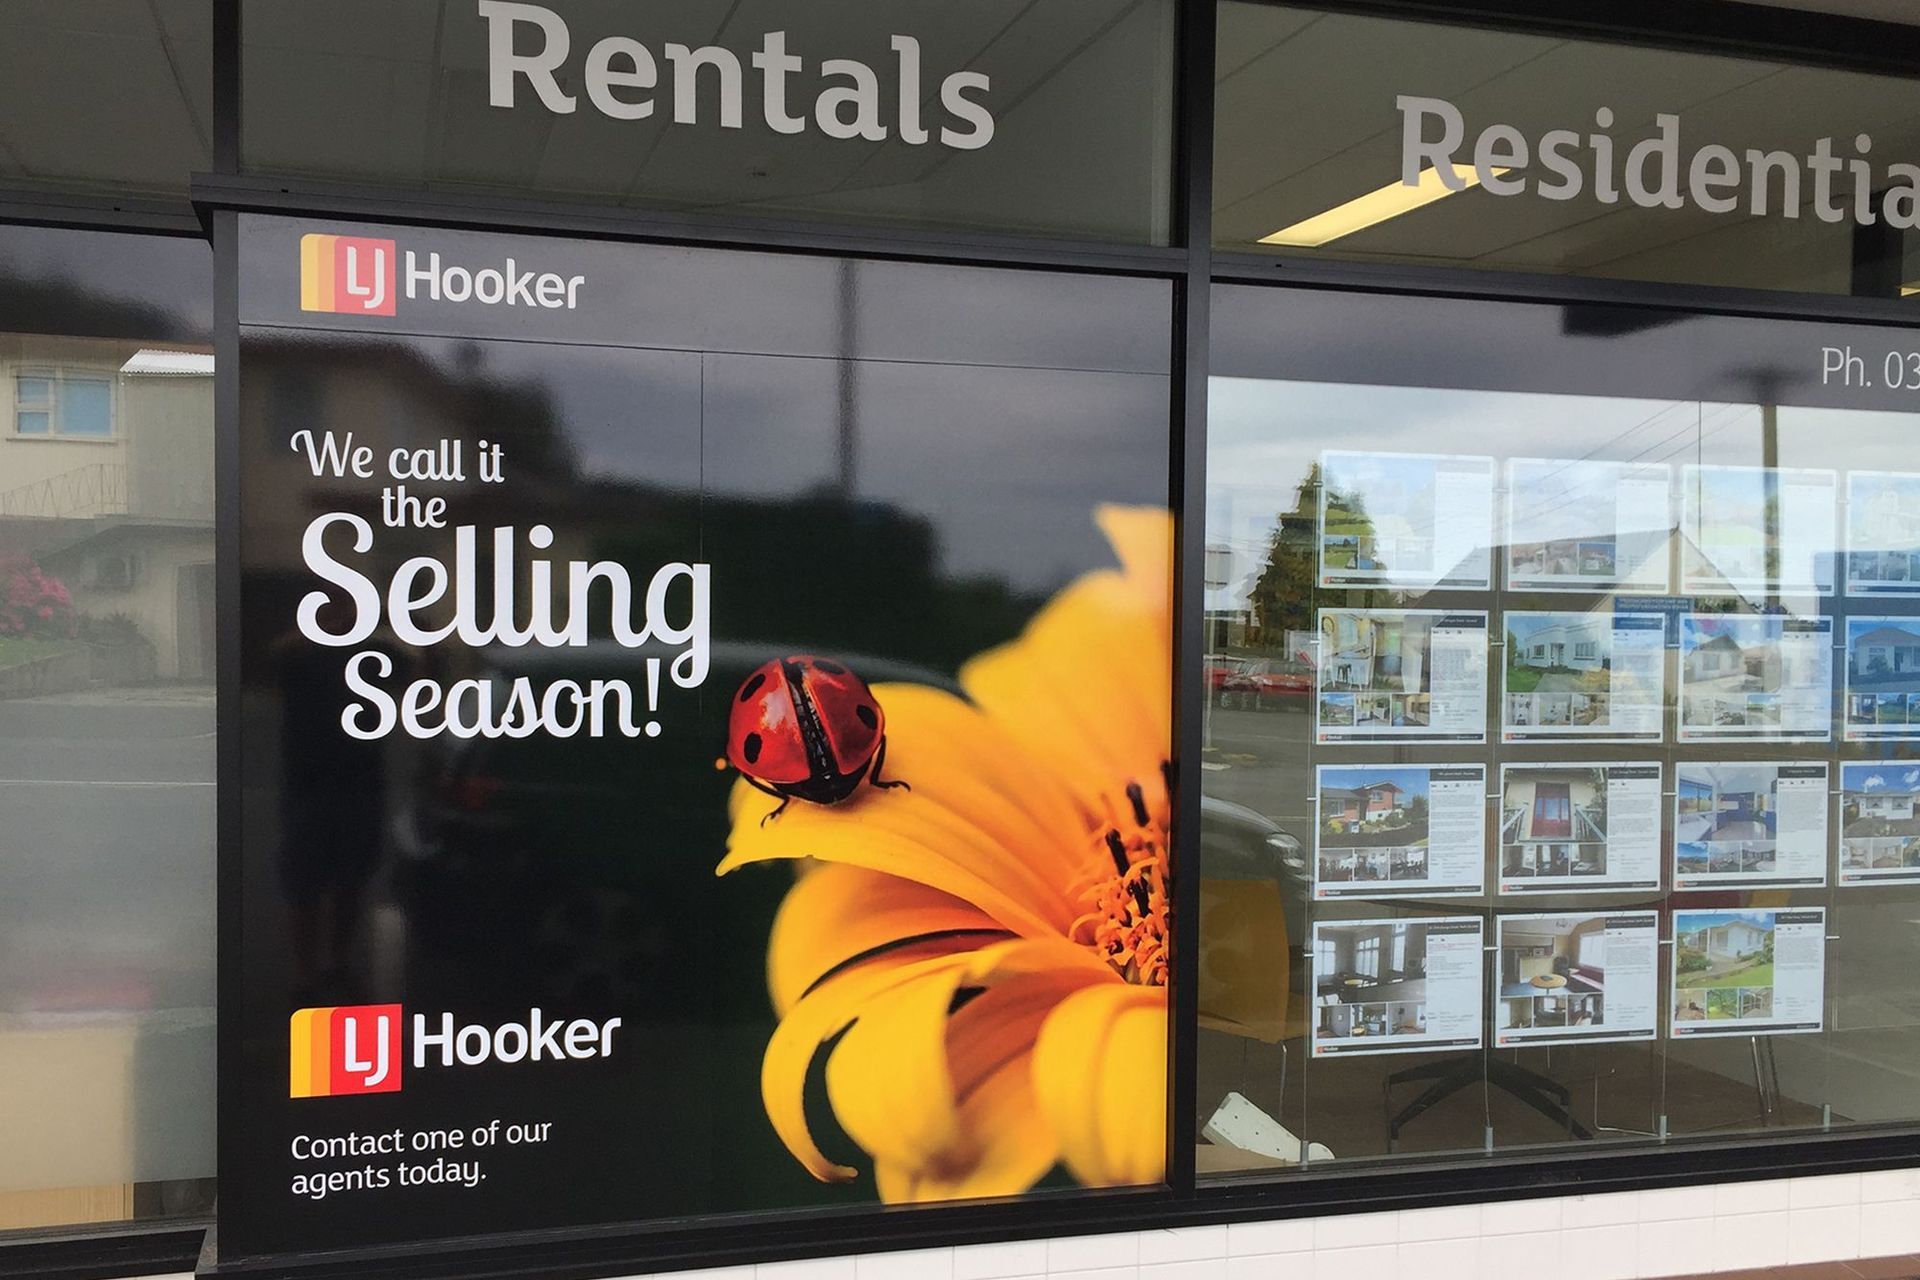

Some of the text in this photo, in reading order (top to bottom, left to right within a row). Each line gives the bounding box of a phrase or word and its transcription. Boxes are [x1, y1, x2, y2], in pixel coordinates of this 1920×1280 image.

[478, 0, 994, 150] Rentals
[1396, 94, 1920, 230] Residentia
[347, 245, 586, 310] LJ Hooker
[1821, 345, 1873, 388] Ph.
[290, 429, 505, 483] We call it
[381, 485, 448, 529] the
[296, 511, 712, 689] Selling
[340, 650, 662, 740] Season!
[344, 1007, 622, 1087] LJ Hooker
[291, 1119, 552, 1160] Contact one of our
[291, 1157, 487, 1200] agents today.
